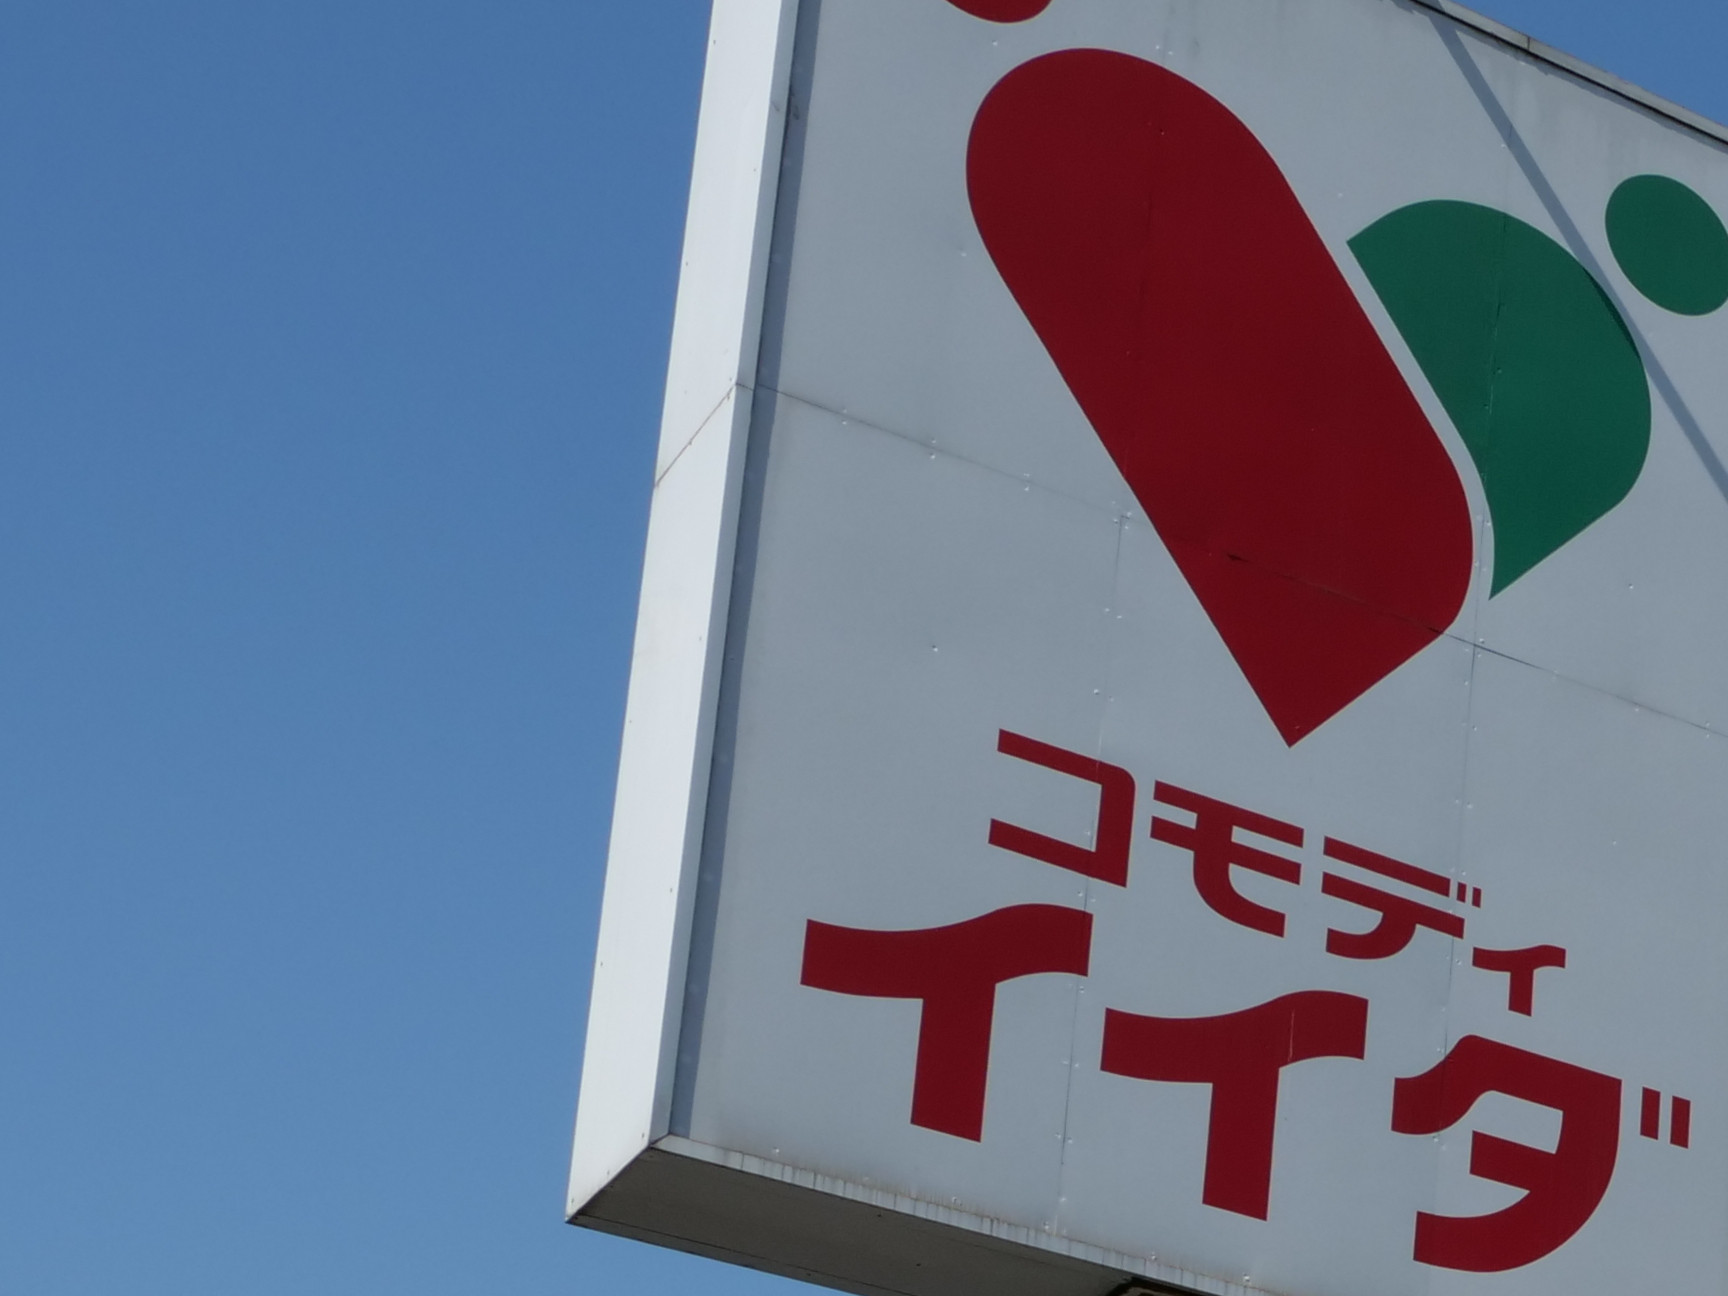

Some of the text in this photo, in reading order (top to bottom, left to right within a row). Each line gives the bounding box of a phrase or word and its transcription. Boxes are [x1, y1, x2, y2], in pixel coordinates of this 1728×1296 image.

[989, 729, 1566, 1016] コモディ
[801, 903, 1690, 1272] イイダ
